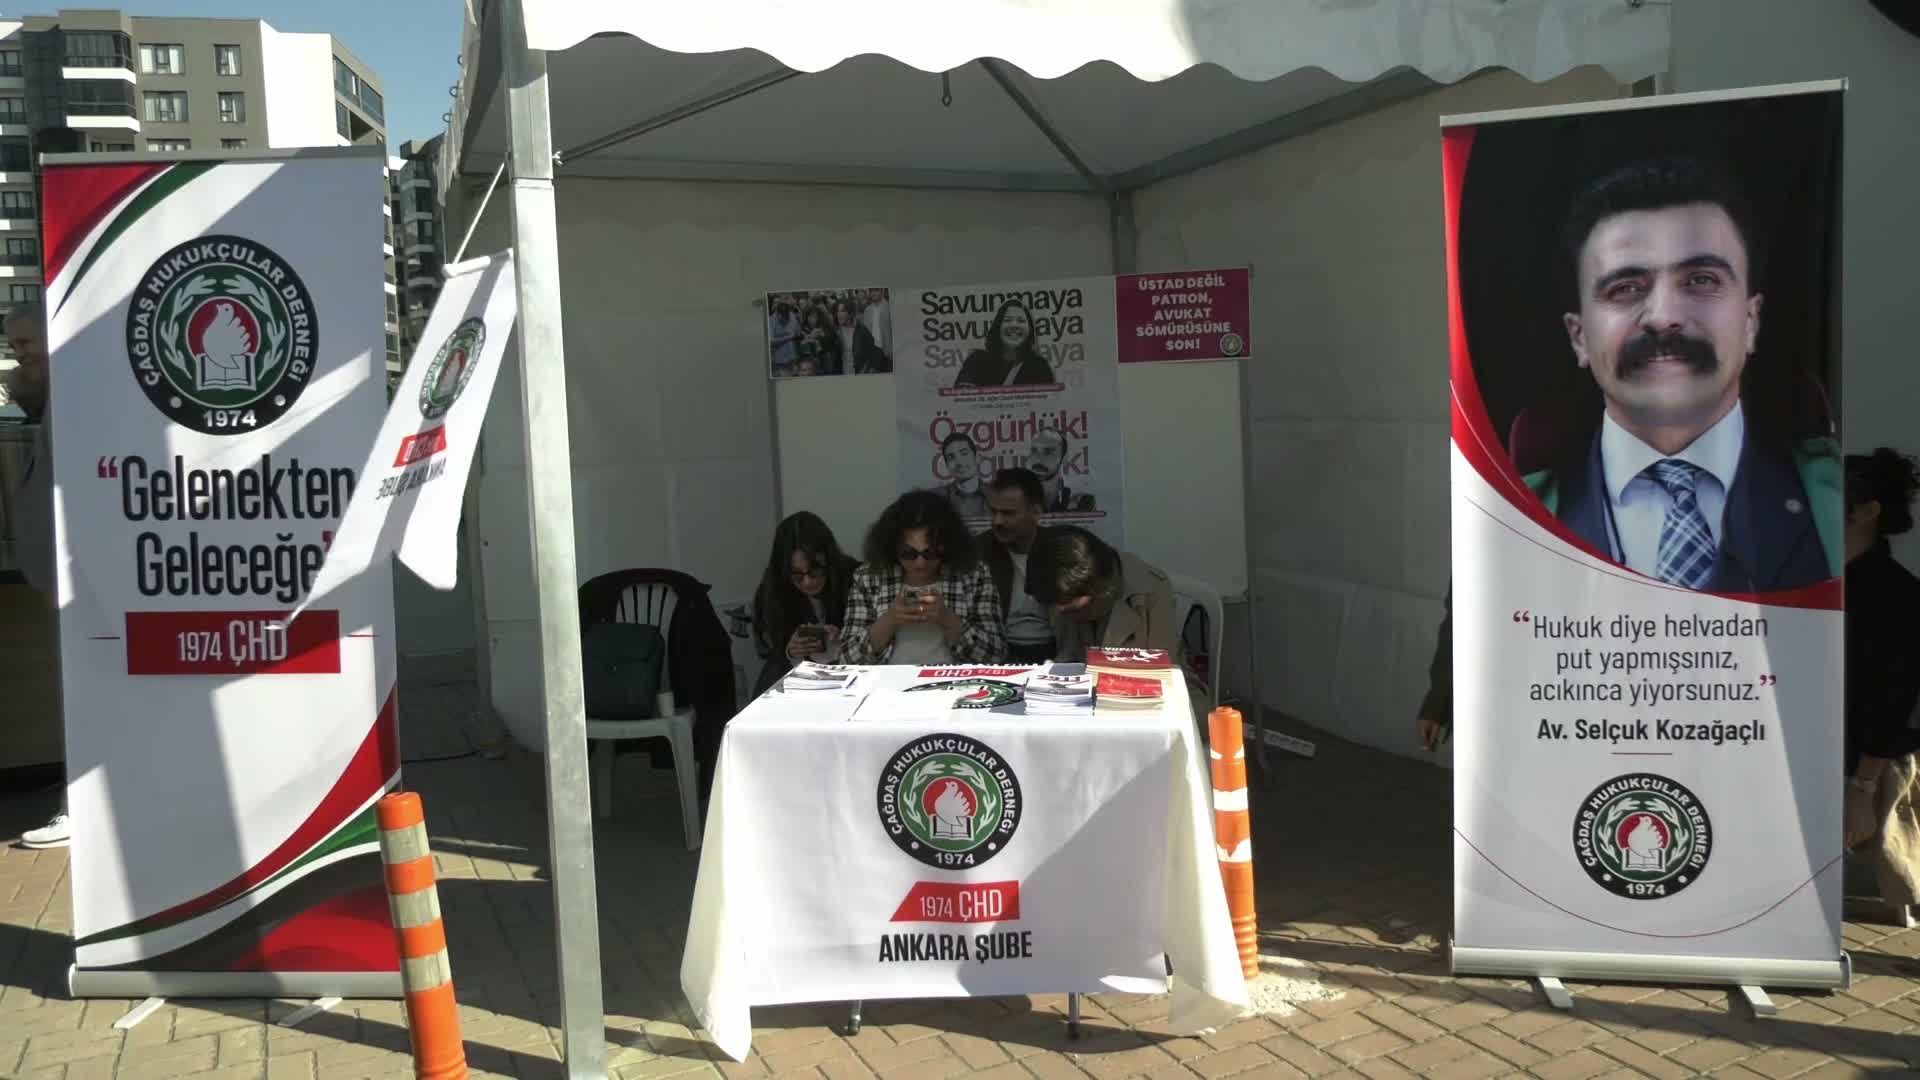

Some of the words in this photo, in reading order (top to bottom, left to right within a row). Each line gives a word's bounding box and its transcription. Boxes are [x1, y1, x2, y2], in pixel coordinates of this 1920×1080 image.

[1138, 278, 1184, 290] ÜSTAD
[1187, 273, 1225, 289] DEĞİL
[1151, 292, 1212, 305] PATRON,
[134, 298, 162, 386] ÇAĞDAŞ
[148, 243, 286, 294] HUKUKÇULAR
[282, 284, 311, 382] DERNEĞİ
[1154, 308, 1212, 321] AVUKAT
[1136, 321, 1231, 337] SÖMÜRÜSÜNE
[1165, 339, 1200, 351] SON!
[203, 410, 257, 427] 1974
[1610, 614, 1657, 643] diye
[1664, 613, 1768, 638] helvadan
[177, 631, 223, 662] 1974
[229, 619, 288, 667] ÇHD
[1556, 649, 1592, 675] put
[1600, 650, 1738, 675] yapmışsınız,
[1530, 679, 1622, 701] acıkınca
[1537, 718, 1568, 740] Av.
[1575, 718, 1649, 744] Selçuk
[1656, 719, 1766, 746] Kozağaçlı
[882, 774, 903, 834] ÇAĞDAŞ
[893, 739, 998, 772] HUKUKÇULAR
[995, 769, 1016, 834] DERNEĞİ
[1577, 810, 1598, 866] ÇAĞDAŞ
[1590, 777, 1690, 809] HUKUKÇULAR
[1688, 806, 1707, 868] DERNEĞİ
[935, 853, 975, 865] 1974
[1626, 883, 1665, 895] 1974
[920, 896, 952, 917] 1974
[958, 889, 1002, 921] ÇHD
[879, 933, 969, 963] ANKARA
[975, 931, 1032, 964] ŞUBE
